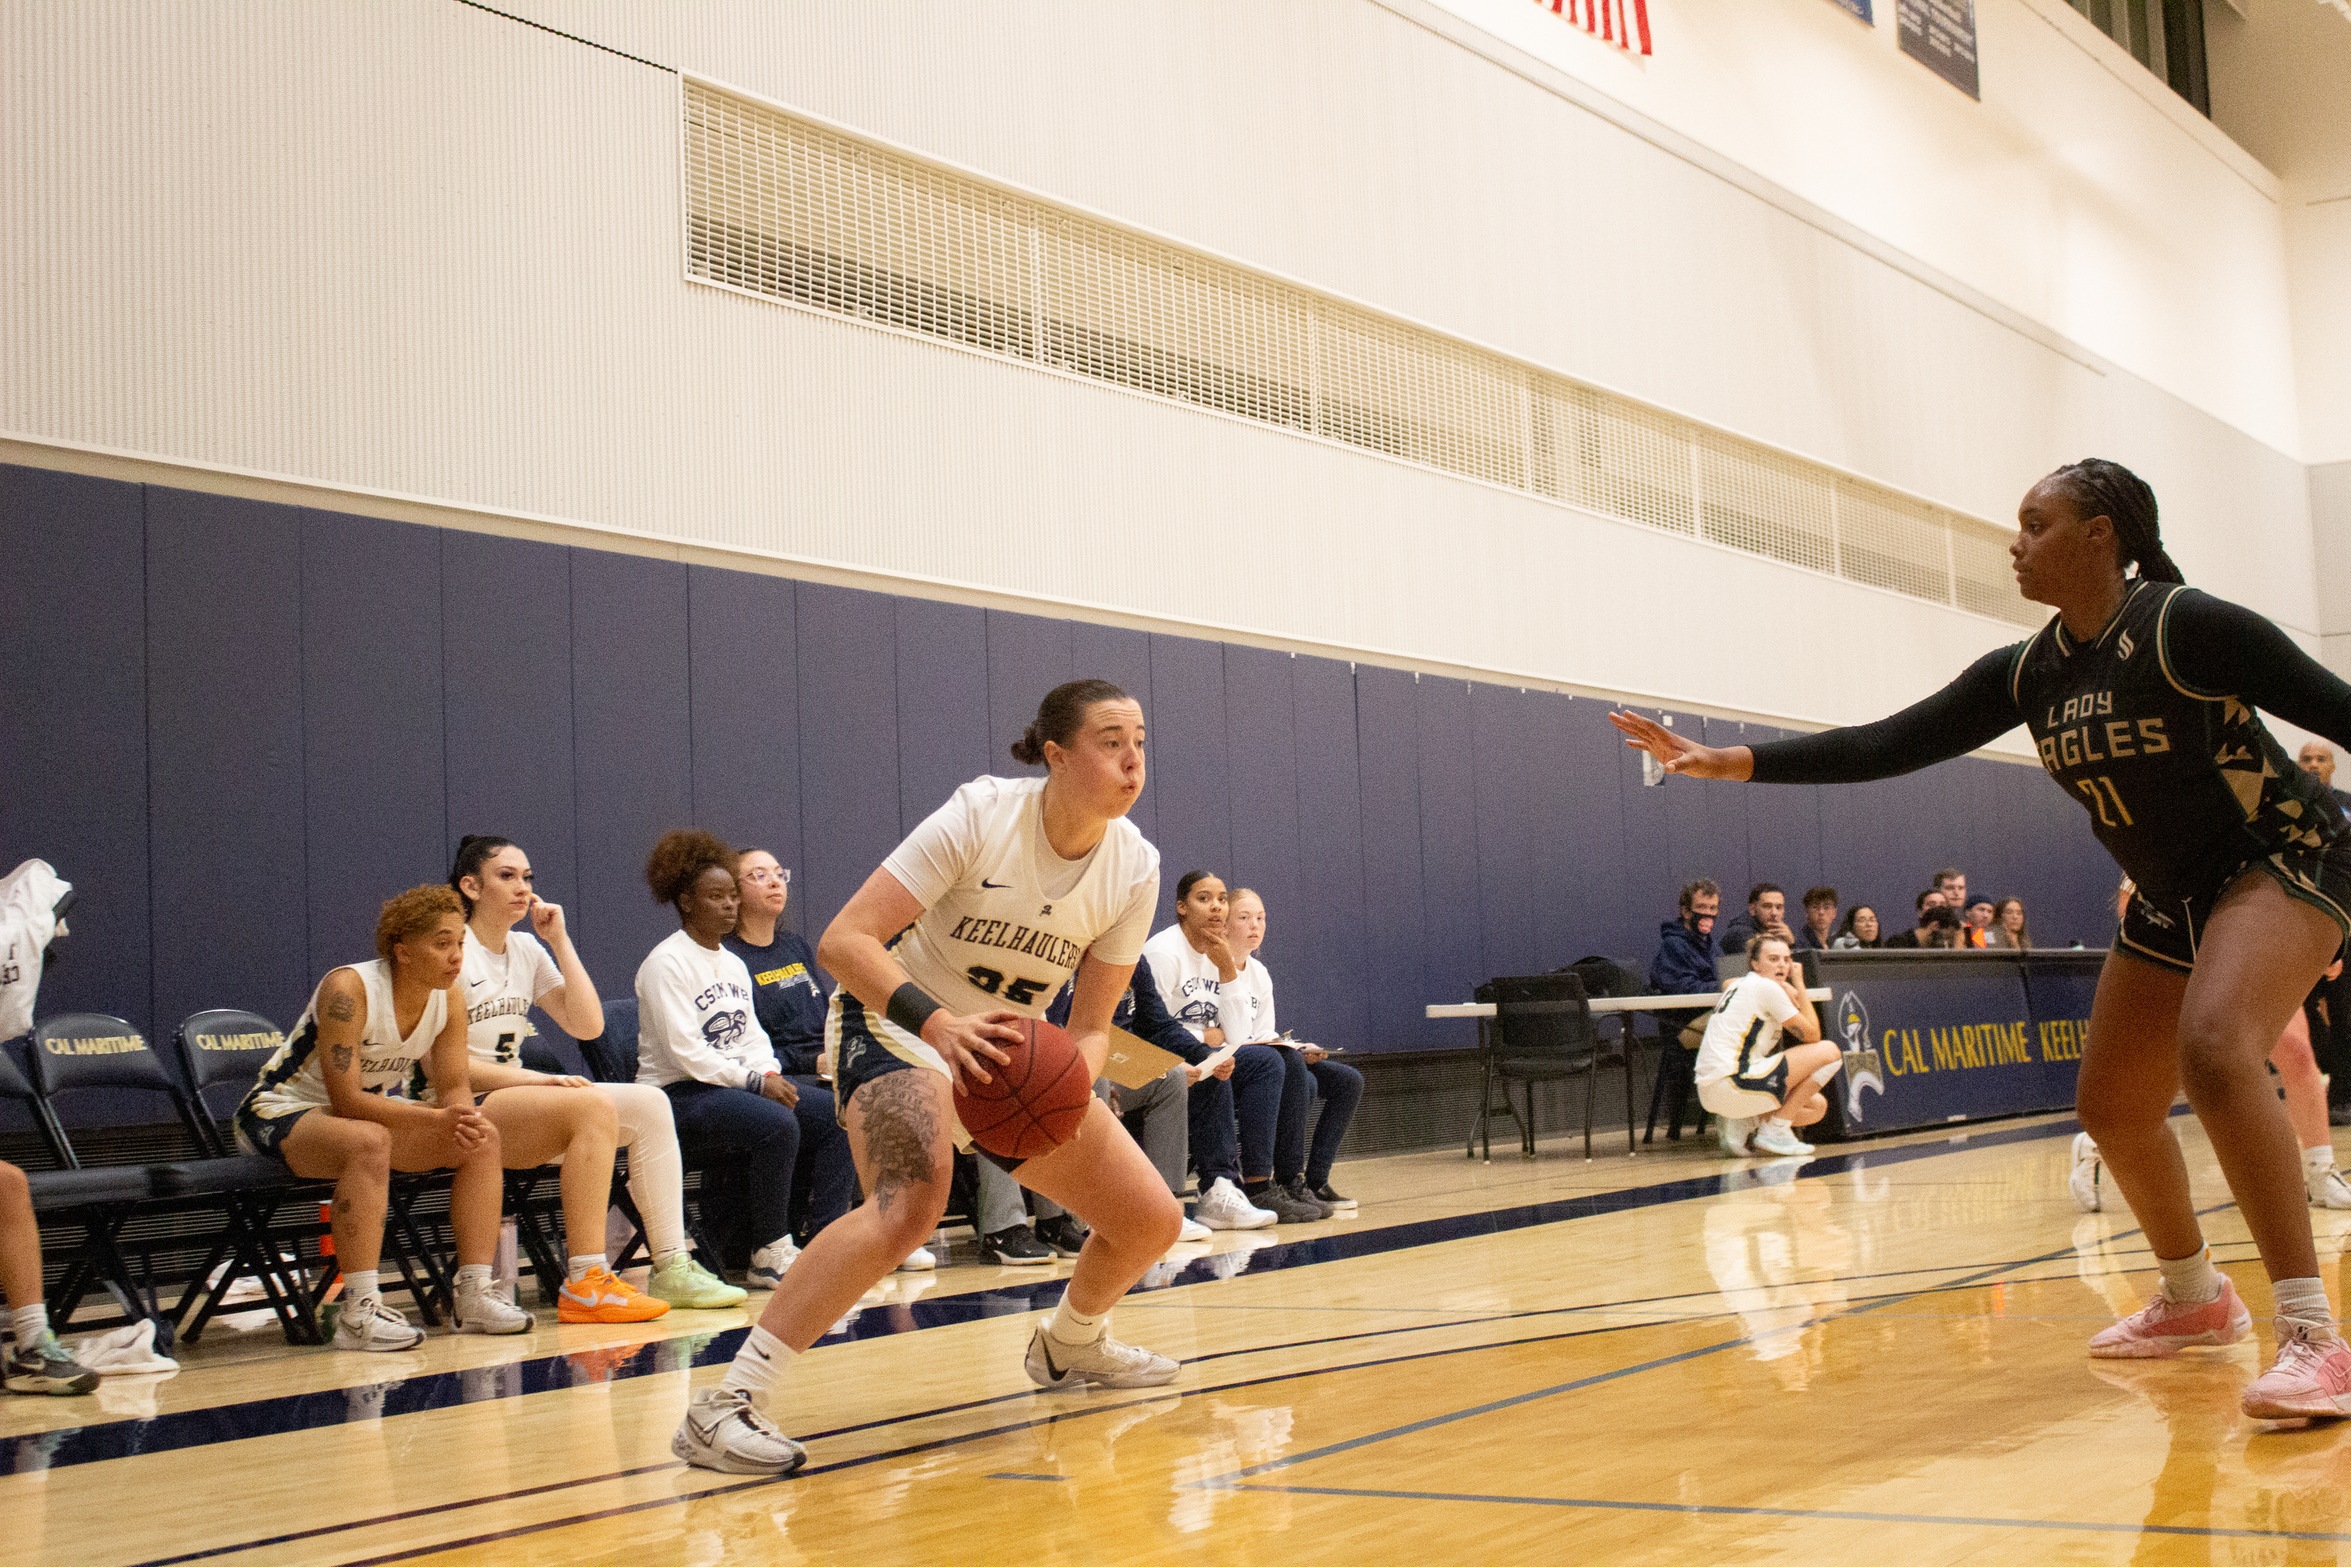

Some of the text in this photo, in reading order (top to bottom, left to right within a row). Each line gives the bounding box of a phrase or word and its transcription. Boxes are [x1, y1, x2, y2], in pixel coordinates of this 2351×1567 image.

[2047, 691, 2112, 728] LADY
[2036, 718, 2171, 773] AGLES
[950, 915, 1081, 970] KEELHAULERS
[45, 1035, 148, 1055] CAL MARITIME
[195, 1031, 286, 1050] CAL MARITIME
[495, 1032, 516, 1063] 5
[1883, 1029, 1930, 1076] CAL
[1930, 1021, 2032, 1072] MARITIME
